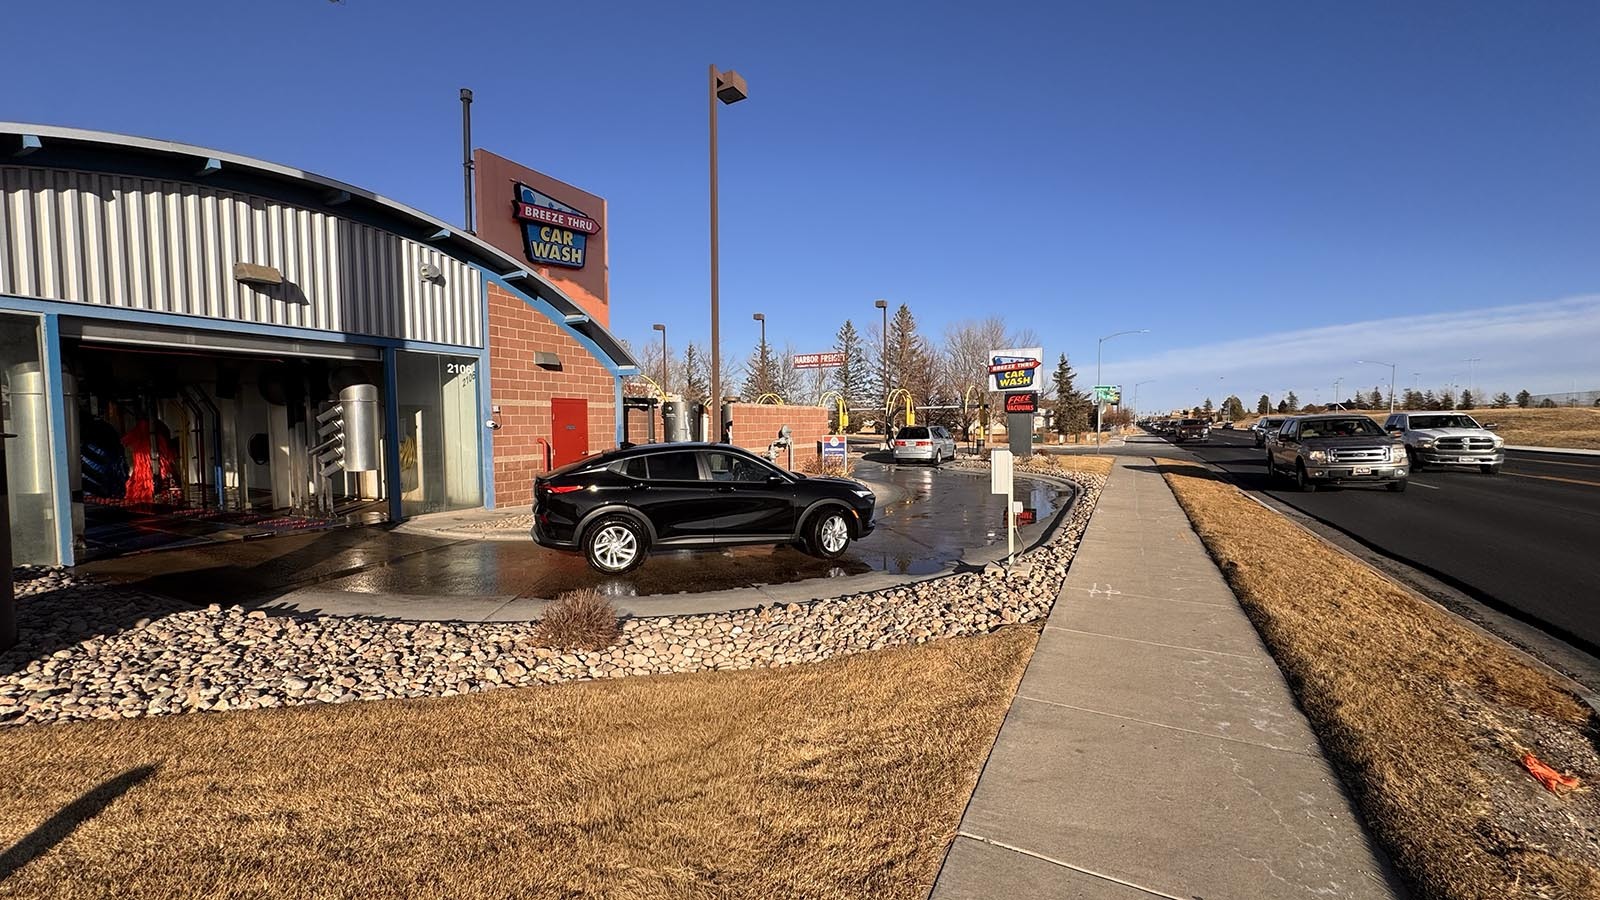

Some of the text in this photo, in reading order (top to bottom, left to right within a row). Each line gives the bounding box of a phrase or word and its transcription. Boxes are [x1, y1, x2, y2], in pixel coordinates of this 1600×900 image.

[525, 206, 592, 230] BREEZE THRU
[540, 226, 573, 246] CAR
[532, 241, 582, 263] WASH
[794, 355, 819, 364] HARBOR
[447, 363, 472, 374] 2106
[1004, 370, 1025, 378] CAR
[1000, 377, 1030, 386] WASH
[1007, 394, 1032, 404] FREE
